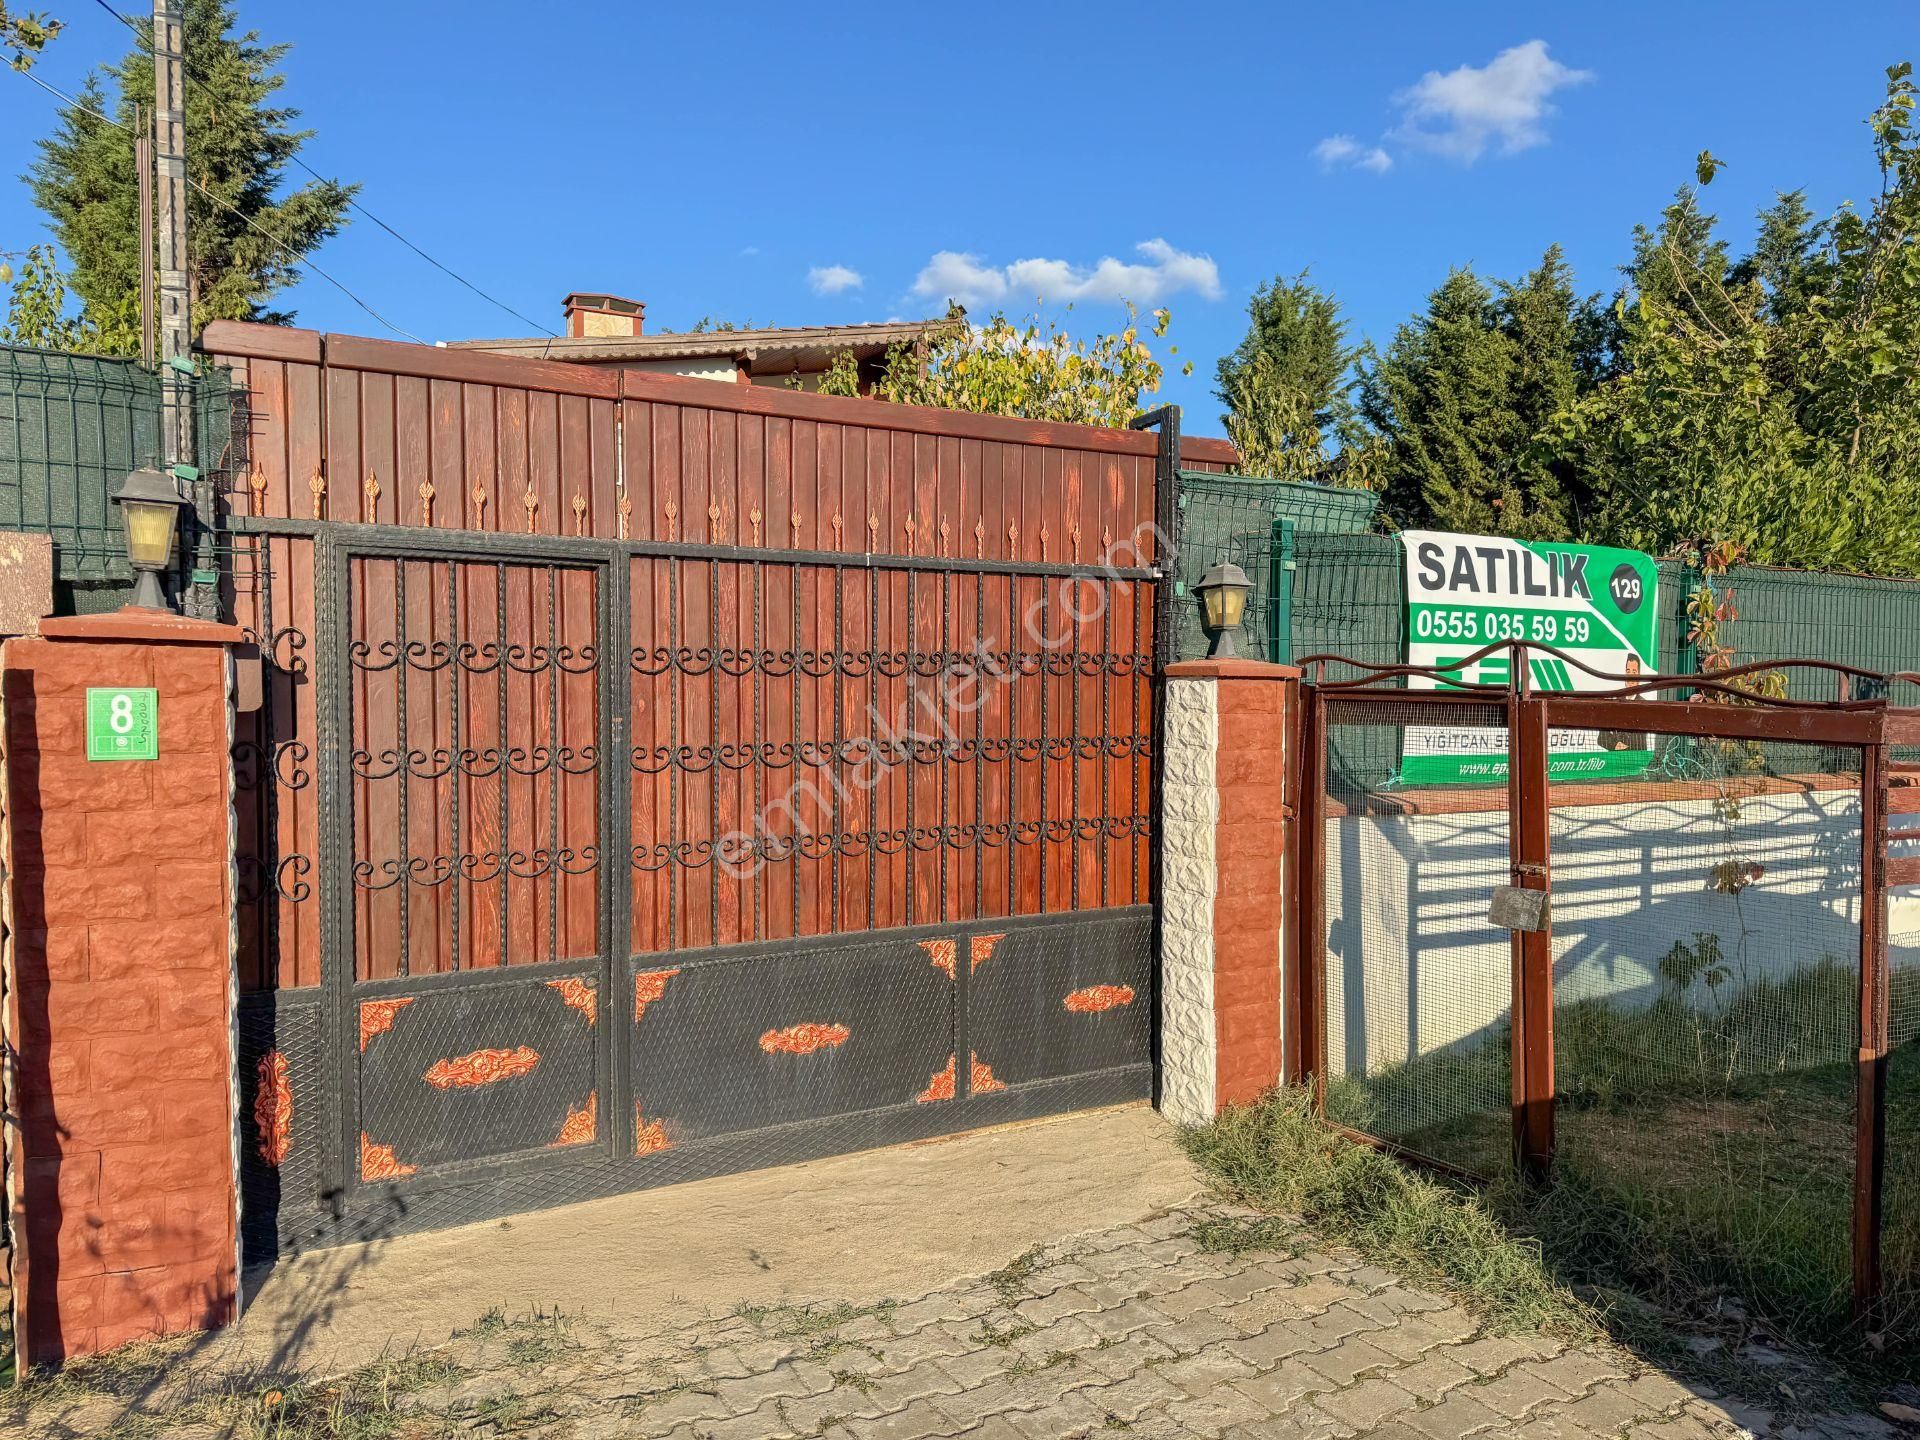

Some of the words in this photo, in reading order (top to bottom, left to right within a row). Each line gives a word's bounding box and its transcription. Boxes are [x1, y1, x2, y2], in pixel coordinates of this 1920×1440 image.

[1418, 542, 1593, 600] SATILIK
[1611, 577, 1641, 599] 129
[1416, 609, 1478, 639] 0555
[1484, 613, 1525, 640] 035
[1531, 615, 1558, 642] 59
[1564, 617, 1590, 643] 59
[110, 693, 134, 734] 8
[1424, 730, 1489, 749] YİĞİTCAN
